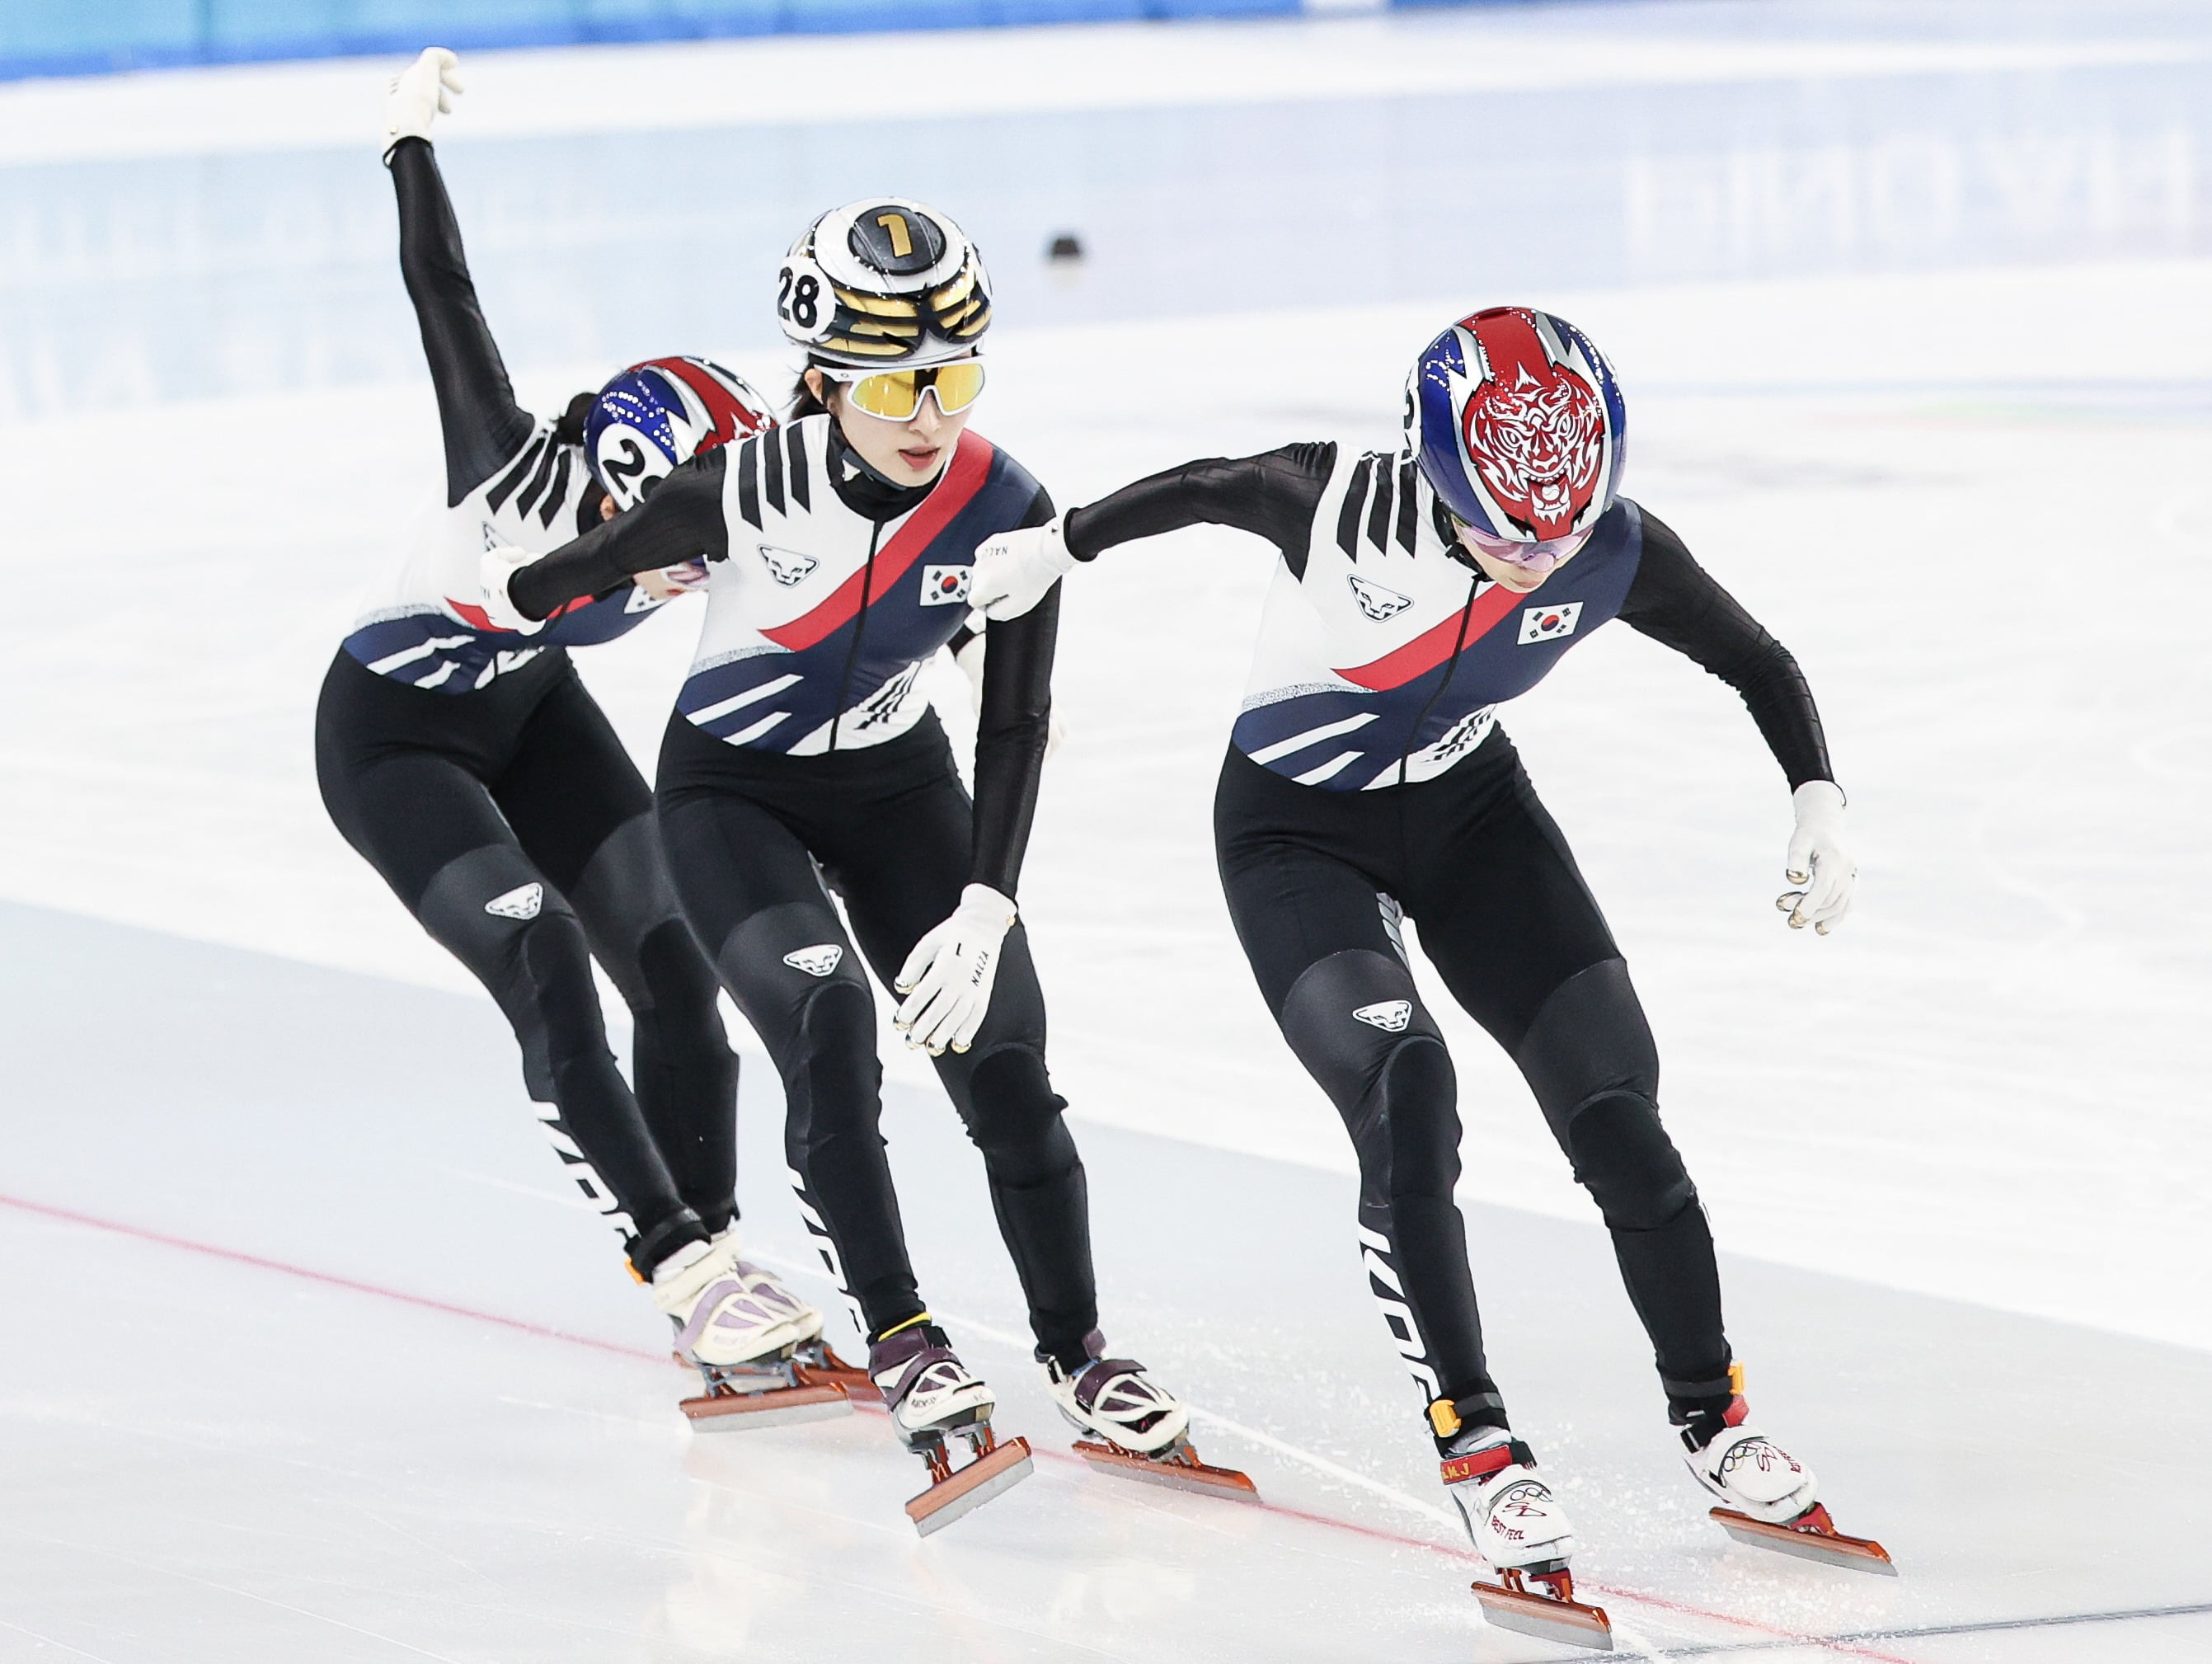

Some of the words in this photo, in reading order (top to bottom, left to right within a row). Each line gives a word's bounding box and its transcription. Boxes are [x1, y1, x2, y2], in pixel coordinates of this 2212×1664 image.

[877, 213, 913, 258] 1
[777, 266, 820, 329] 28
[971, 950, 989, 987] NALZA
